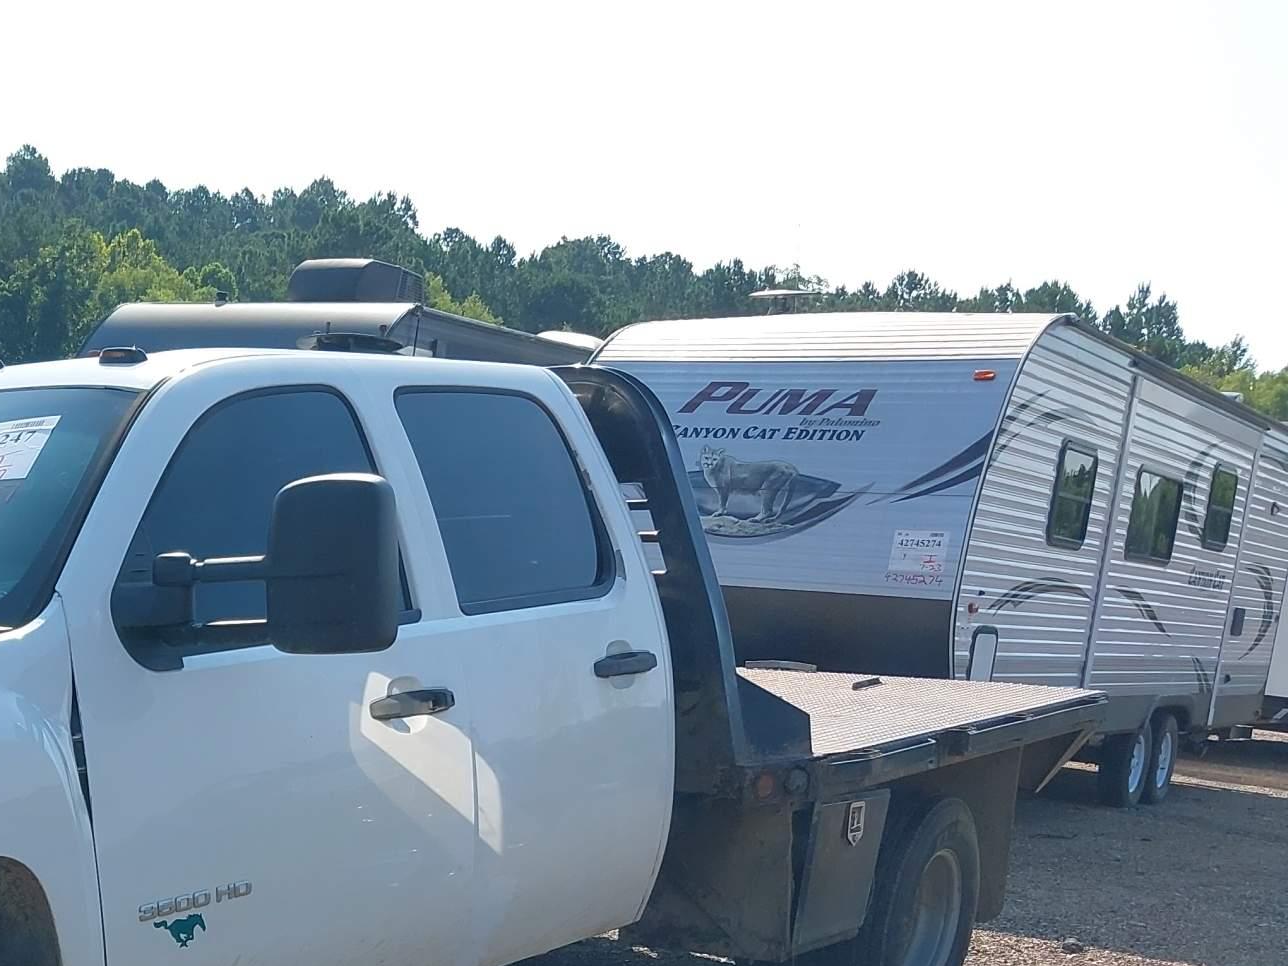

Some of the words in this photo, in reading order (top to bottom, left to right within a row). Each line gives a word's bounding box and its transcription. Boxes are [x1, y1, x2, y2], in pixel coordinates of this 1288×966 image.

[677, 381, 879, 417] PUMA
[799, 417, 817, 429] by
[818, 417, 881, 428] Palomino
[742, 425, 781, 440] CAT
[781, 427, 867, 441] EDITION
[897, 539, 942, 548] 42745274
[138, 890, 211, 922] 3500
[215, 879, 252, 903] HD
